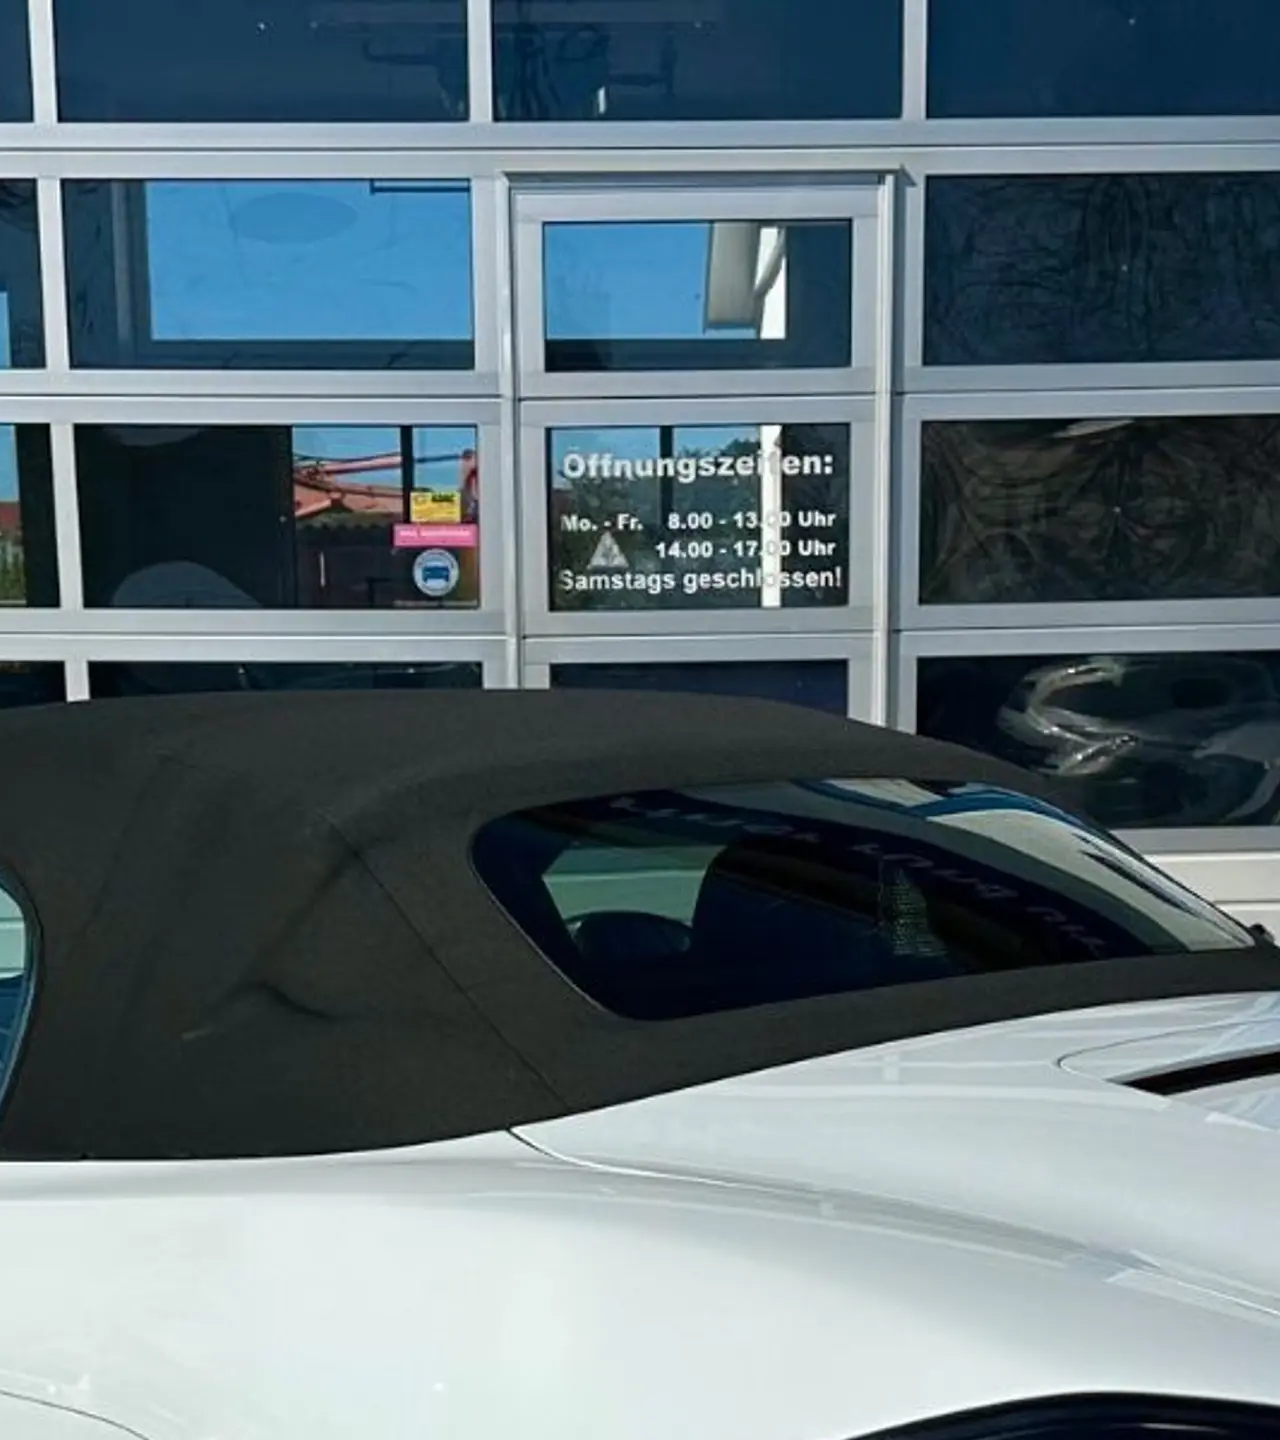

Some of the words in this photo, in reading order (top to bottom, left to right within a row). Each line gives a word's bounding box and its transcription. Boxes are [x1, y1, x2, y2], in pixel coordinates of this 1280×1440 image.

[561, 514, 598, 532] Mo.
[616, 513, 644, 531] Fr.
[667, 512, 713, 530] 8.00
[798, 511, 837, 528] Uhr
[656, 541, 713, 558] 14.00
[798, 540, 837, 557] Uhr
[560, 568, 676, 594] Samstags
[683, 566, 842, 593] geschlossen!
